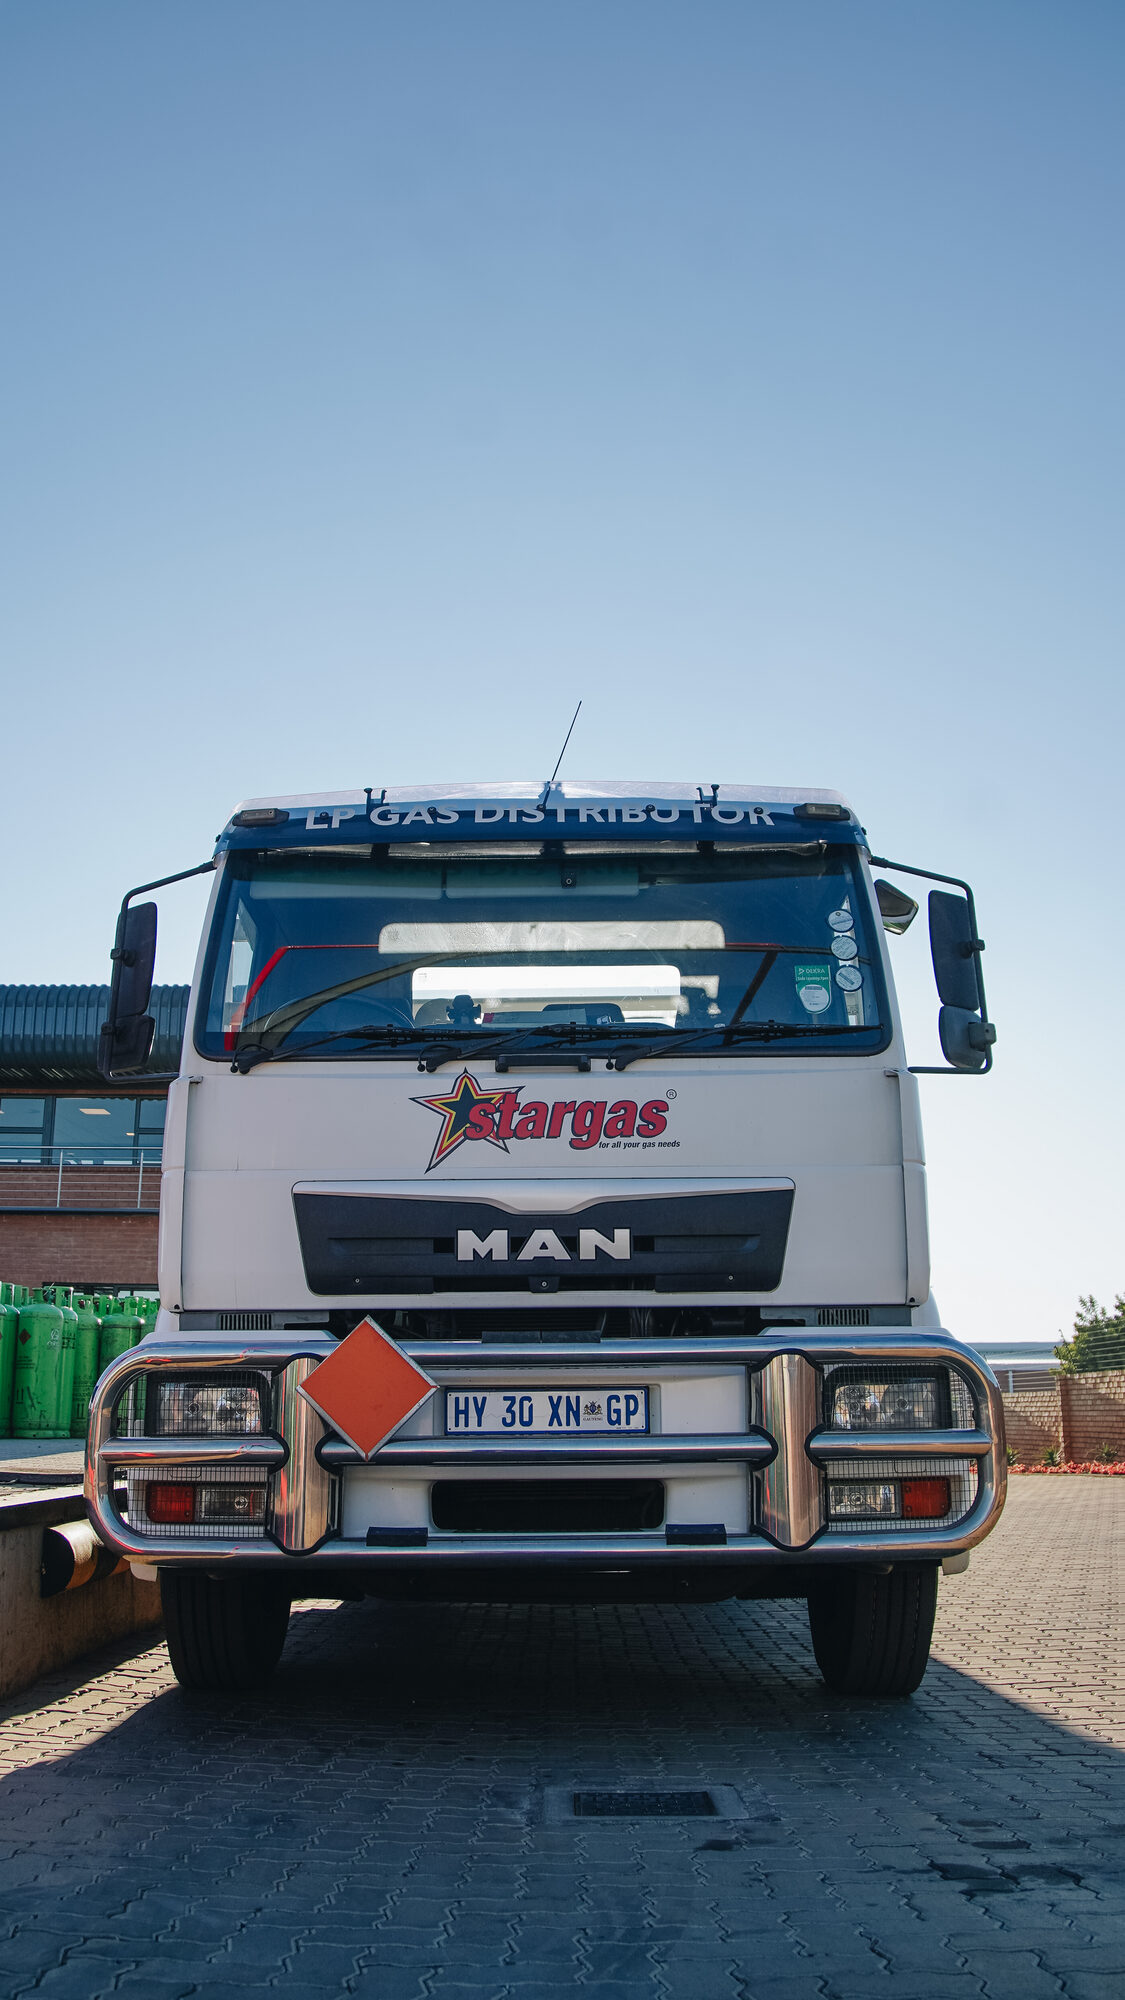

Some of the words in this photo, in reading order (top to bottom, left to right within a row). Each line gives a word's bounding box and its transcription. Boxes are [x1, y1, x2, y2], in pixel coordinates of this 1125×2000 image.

[305, 808, 356, 830] LP
[369, 804, 460, 826] GAS
[474, 802, 775, 826] DISTRIBUTOR
[463, 1092, 669, 1150] stargas
[623, 1142, 640, 1150] your
[641, 1141, 656, 1150] gas
[657, 1140, 681, 1148] needs
[457, 1228, 631, 1261] MAN
[454, 1396, 487, 1428] HY
[501, 1395, 533, 1428] 30
[548, 1395, 581, 1427] XN
[606, 1394, 639, 1426] GP
